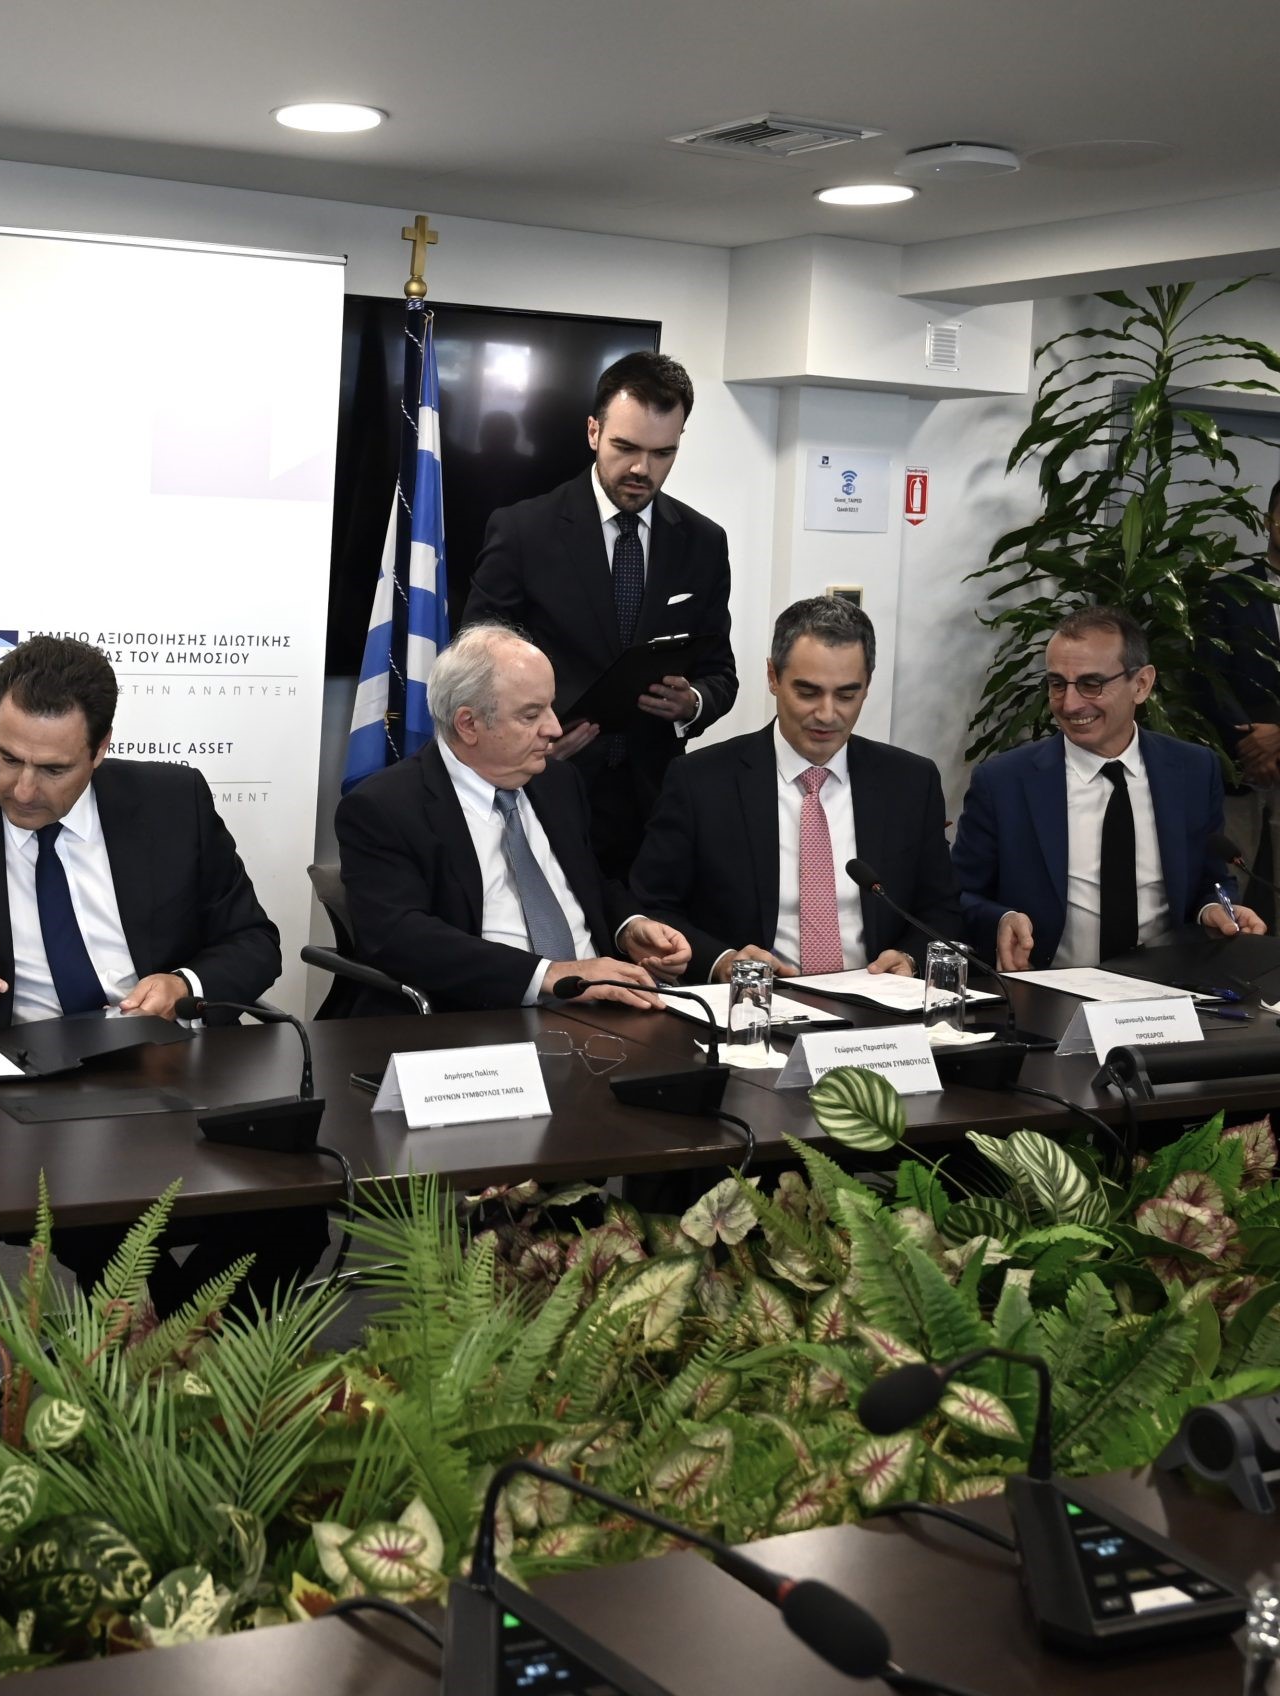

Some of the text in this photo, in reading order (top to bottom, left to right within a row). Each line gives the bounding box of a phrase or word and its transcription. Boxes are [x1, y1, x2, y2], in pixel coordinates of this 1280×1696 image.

[96, 632, 206, 647] ΑΞΙΟΠΟΙΗΣΗΣ
[213, 634, 291, 648] ΙΔΙΩΤΙΚΗΣ
[131, 651, 160, 664] ΤΟΥ
[165, 652, 250, 665] ΔΗΜΟΣΙΟΥ
[117, 684, 297, 697] ΣΤΗΝ ΑΝΑΠΤΥΞΗ
[107, 742, 234, 755] REPUBLIC ASSET
[1135, 1031, 1164, 1040] ΠΡΟΕΔΡΟΣ
[893, 1057, 930, 1067] ΣΥΜΒΟΥΛΟΣ
[444, 1069, 498, 1080] Δημήτρης Πολίτης
[424, 1086, 524, 1103] ΔΙΕΥΘΥΝΩΝ ΣΥΜΒΟΥΛΟΣ ΤΑΙΠΕΔ
